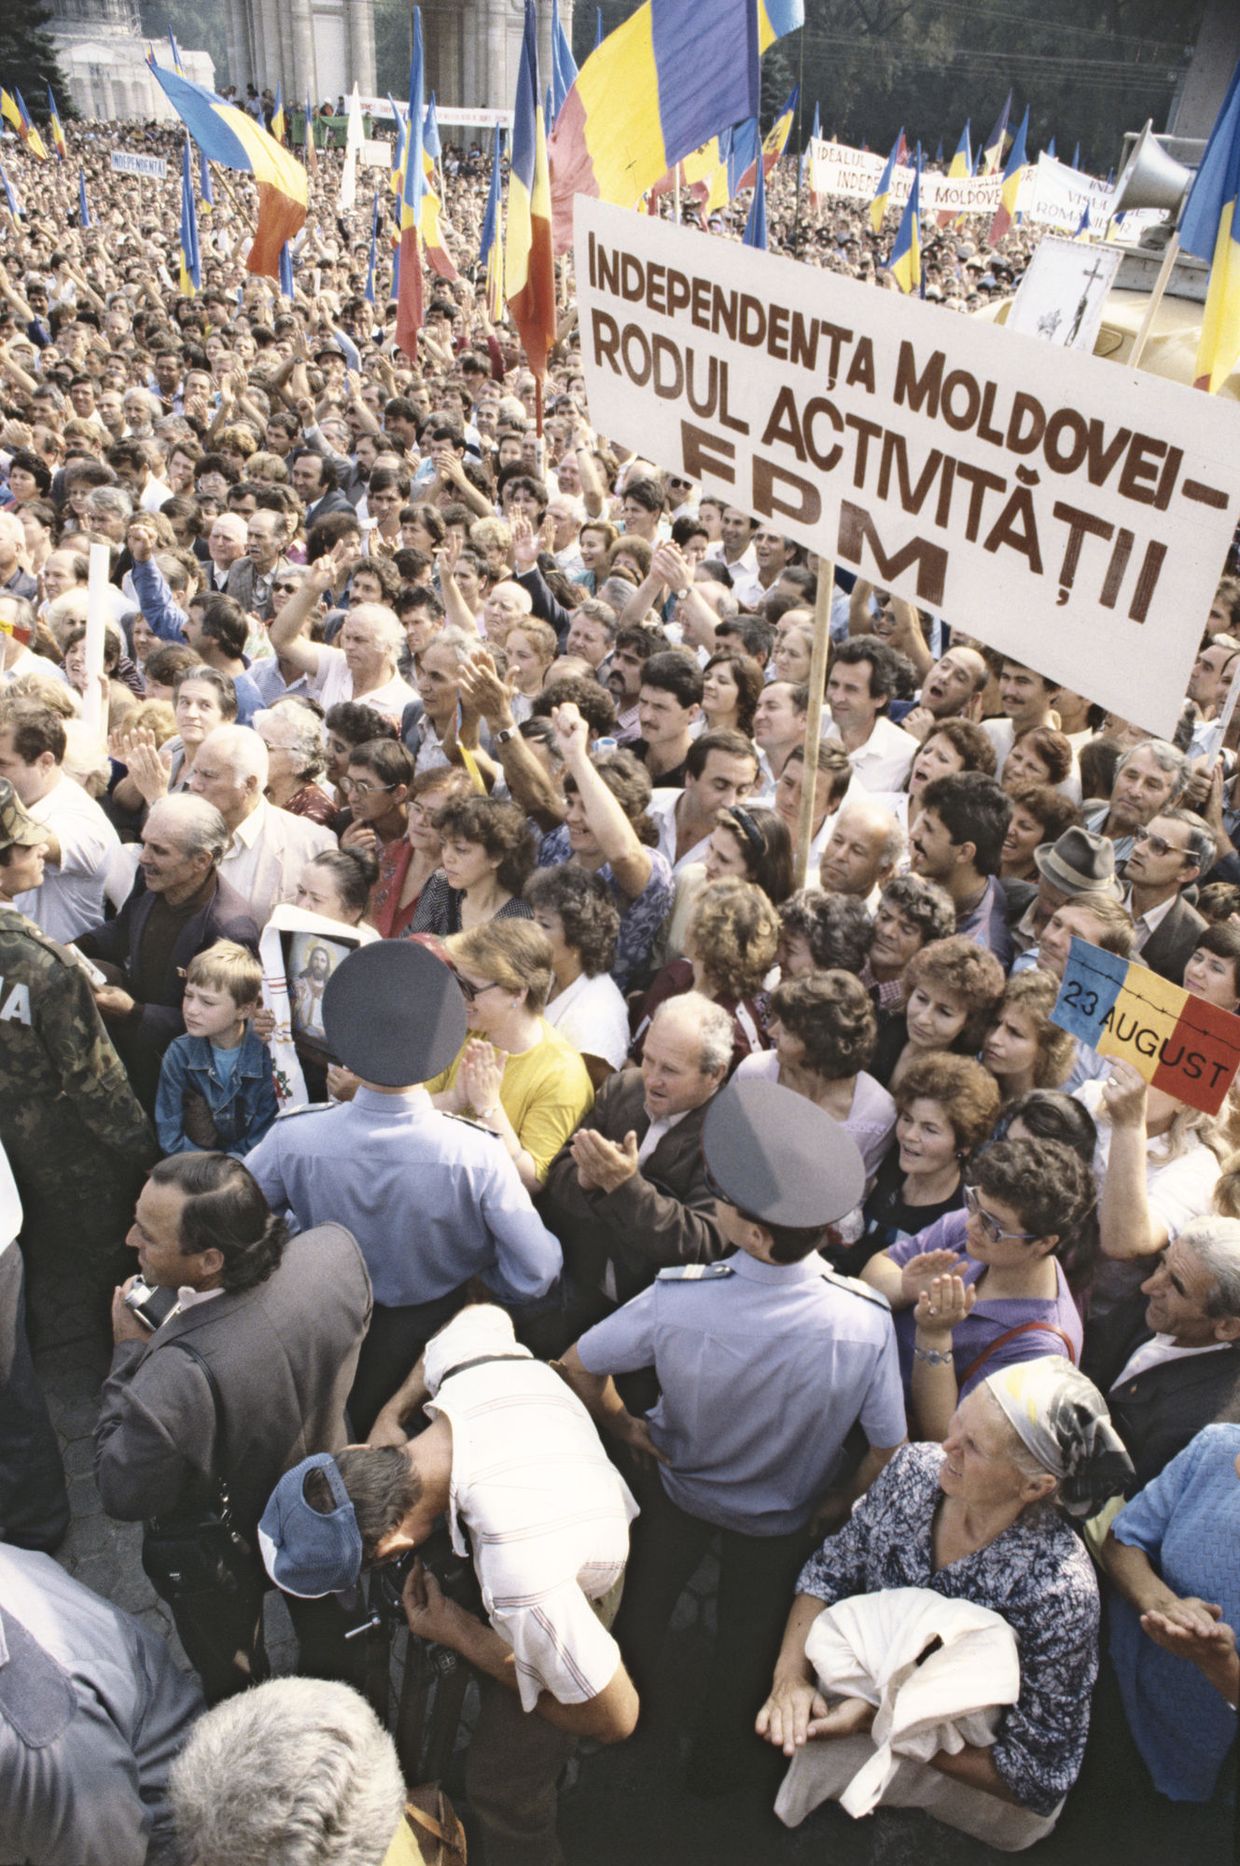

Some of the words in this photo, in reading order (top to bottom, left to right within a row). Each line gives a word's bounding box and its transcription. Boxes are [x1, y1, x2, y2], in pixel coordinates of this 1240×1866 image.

[592, 308, 750, 436] RODUL
[761, 386, 1168, 624] ACTIVITĂȚII
[0, 976, 32, 1026] A
[1064, 981, 1099, 1016] 23
[1098, 1006, 1229, 1088] AUGUST
